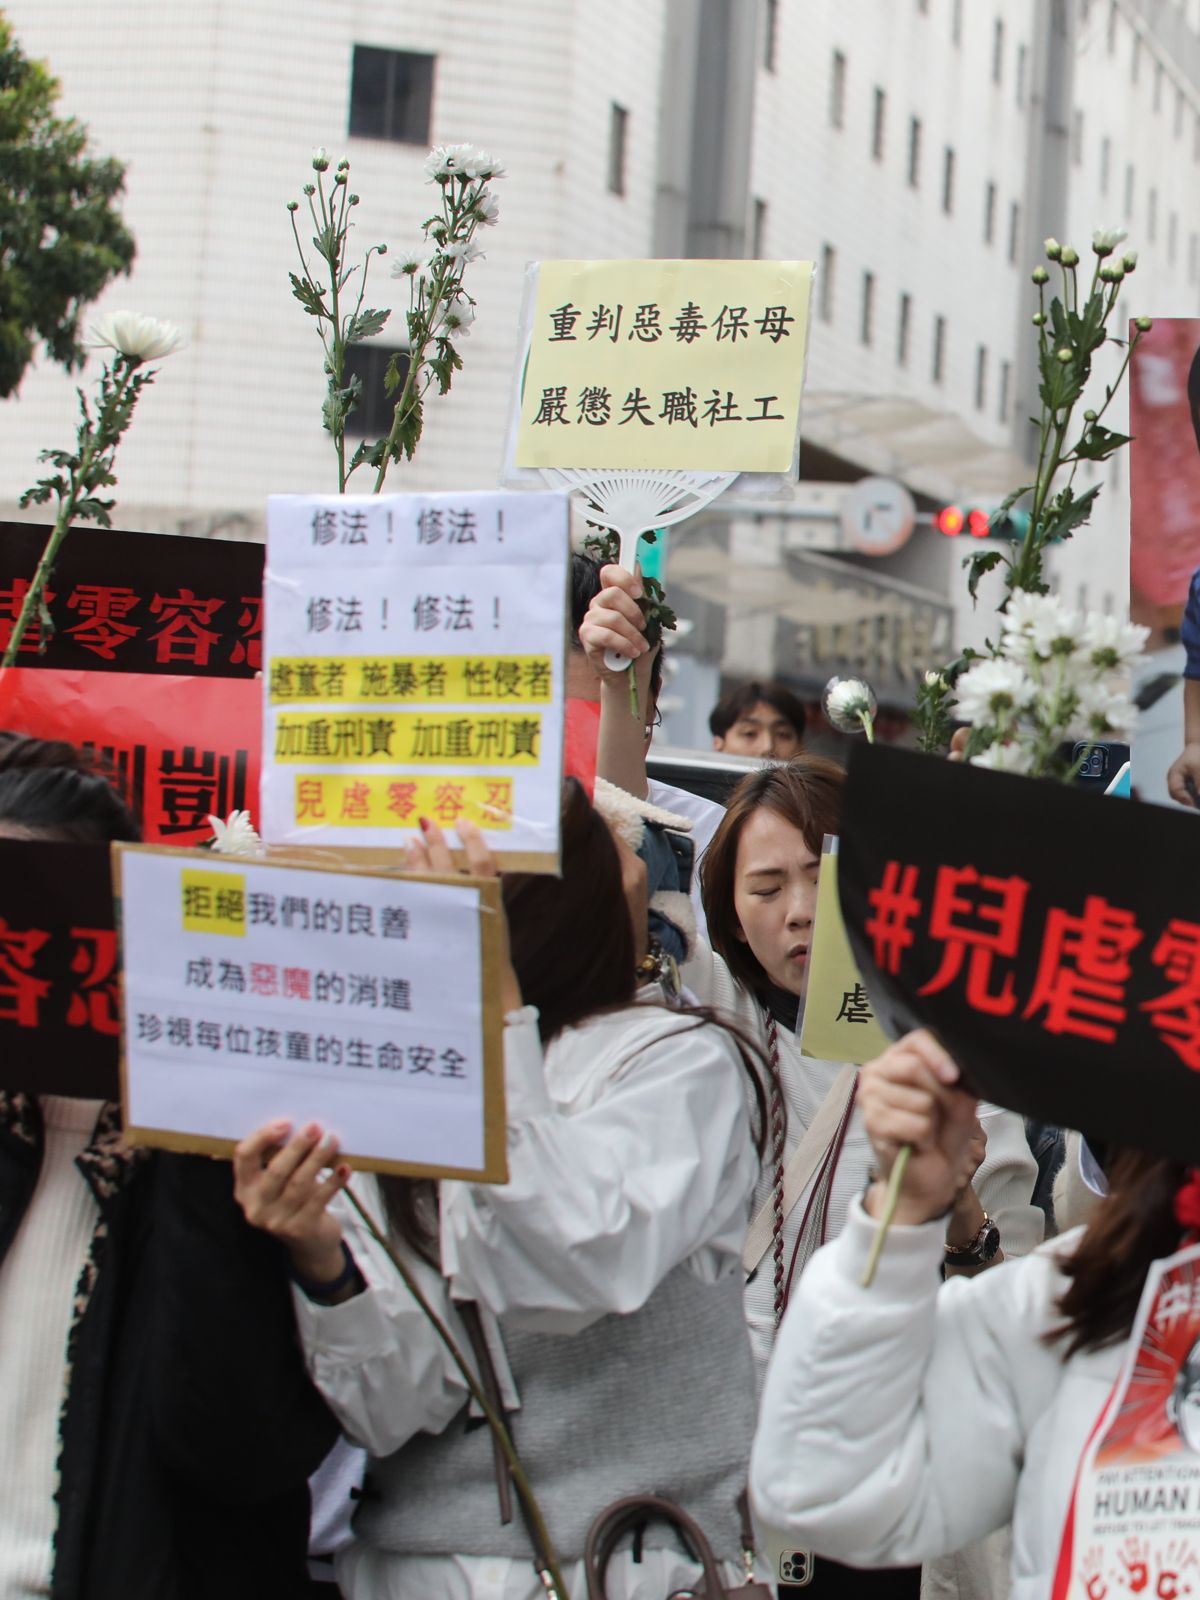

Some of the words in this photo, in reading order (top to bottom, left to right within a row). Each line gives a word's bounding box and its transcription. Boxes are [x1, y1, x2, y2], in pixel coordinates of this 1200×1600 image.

[548, 302, 795, 344] 重判惡毒保母
[532, 386, 785, 428] 嚴懲失職社工
[269, 661, 347, 697] 虐童者
[360, 661, 447, 697] 施暴者
[463, 661, 552, 697] 性侵者
[275, 717, 396, 757] 加重刑責
[411, 717, 540, 758] 加重刑責
[296, 780, 513, 823] 兒虐零容忍
[183, 885, 411, 940] 拒絕我們的良善
[185, 957, 412, 1012] 成為惡魔的消遣
[136, 1013, 468, 1080] 珍視每位孩童的生命安全
[1093, 1486, 1191, 1518] HUMAN
